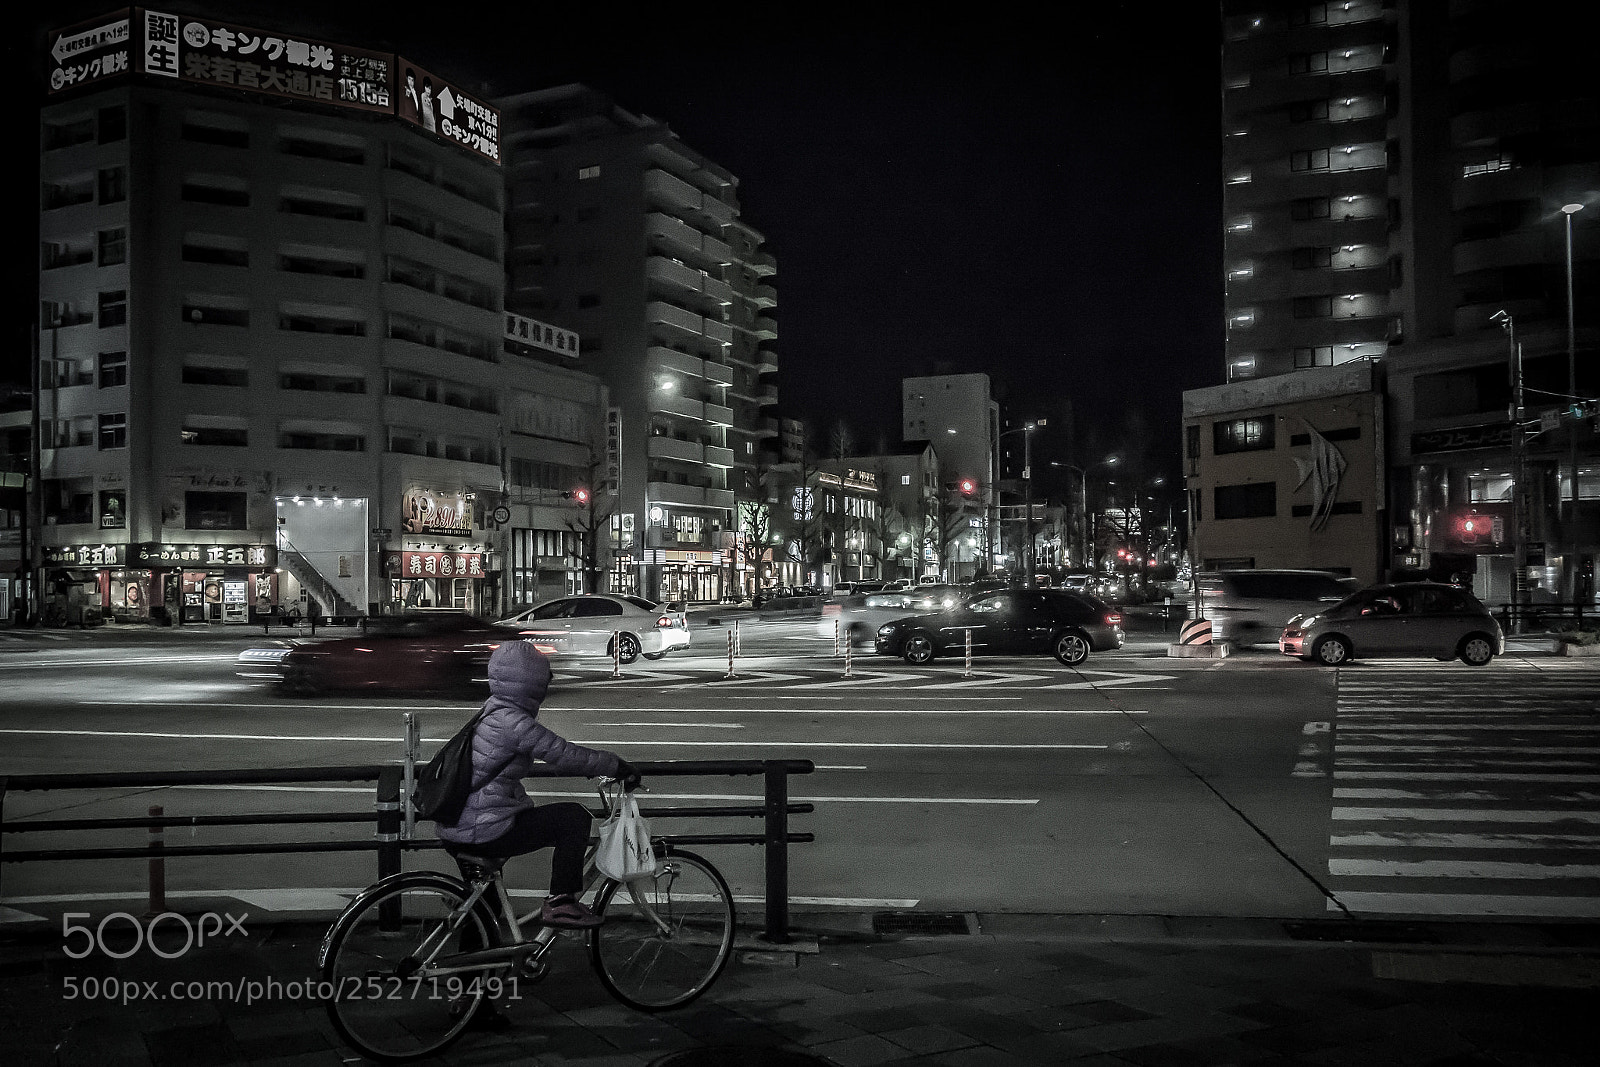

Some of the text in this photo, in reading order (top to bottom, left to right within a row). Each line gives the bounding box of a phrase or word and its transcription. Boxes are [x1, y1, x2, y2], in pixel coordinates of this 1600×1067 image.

[147, 14, 178, 74] 誕生
[212, 27, 335, 71] キング観光
[65, 50, 129, 85] キング観光
[184, 51, 335, 101] 栄若宮大通店
[337, 78, 390, 107] 1515台
[79, 546, 117, 565] 正五郎
[206, 547, 267, 565] 正五郎
[409, 554, 437, 575] 寿司
